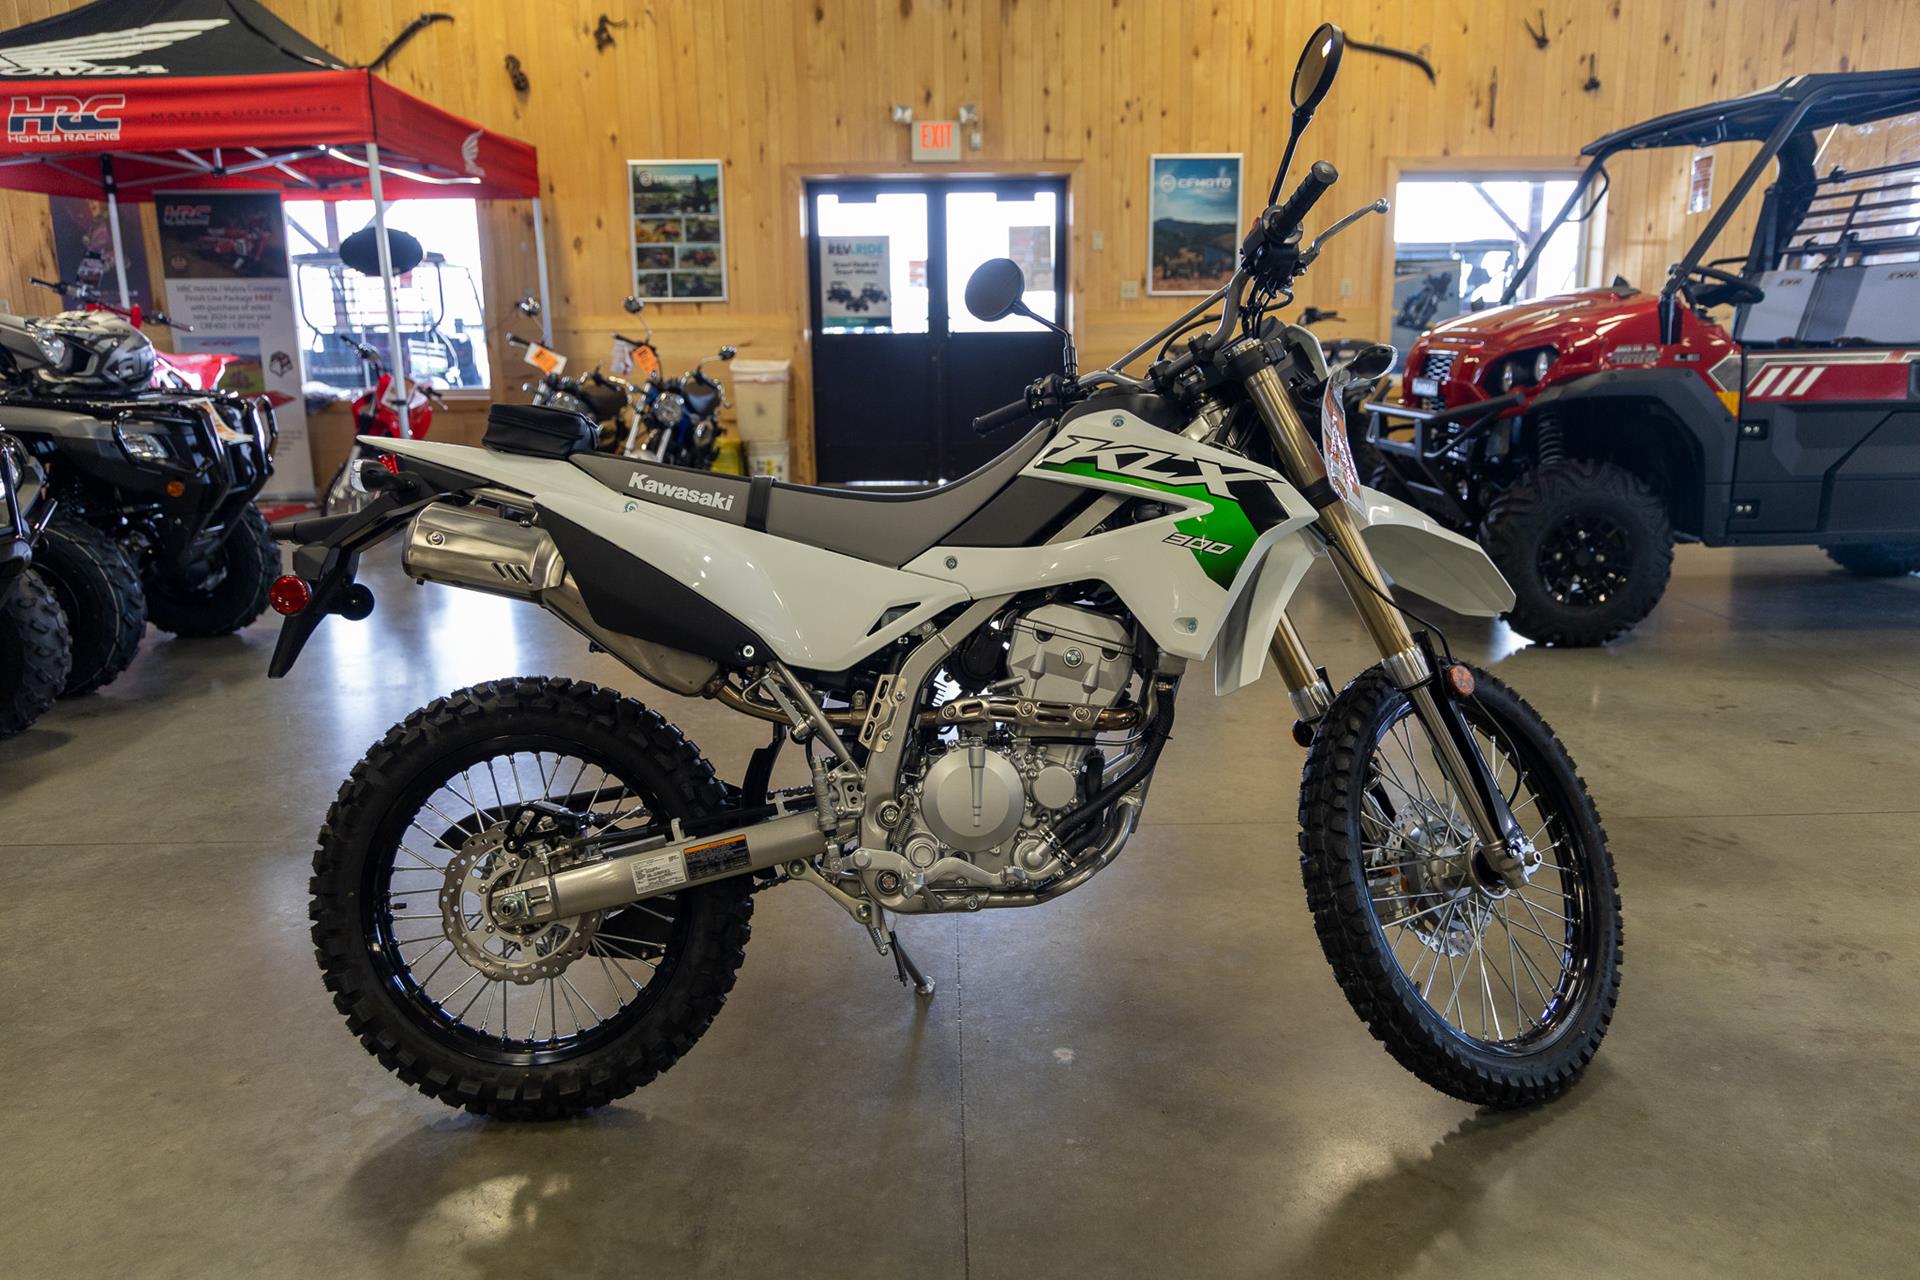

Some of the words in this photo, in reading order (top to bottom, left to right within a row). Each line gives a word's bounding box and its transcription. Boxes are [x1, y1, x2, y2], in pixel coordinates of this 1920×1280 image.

[0, 65, 169, 76] ONDA
[8, 94, 126, 134] HRC
[151, 111, 221, 121] MATRIX
[232, 105, 341, 117] CONCEPTS
[8, 133, 61, 143] Honda
[64, 132, 121, 141] RACING
[920, 123, 953, 148] EXIT
[1178, 177, 1233, 189] CFMOTO
[1035, 435, 1287, 501] KLX
[628, 471, 735, 511] Kawasaki
[1161, 531, 1235, 555] 300
